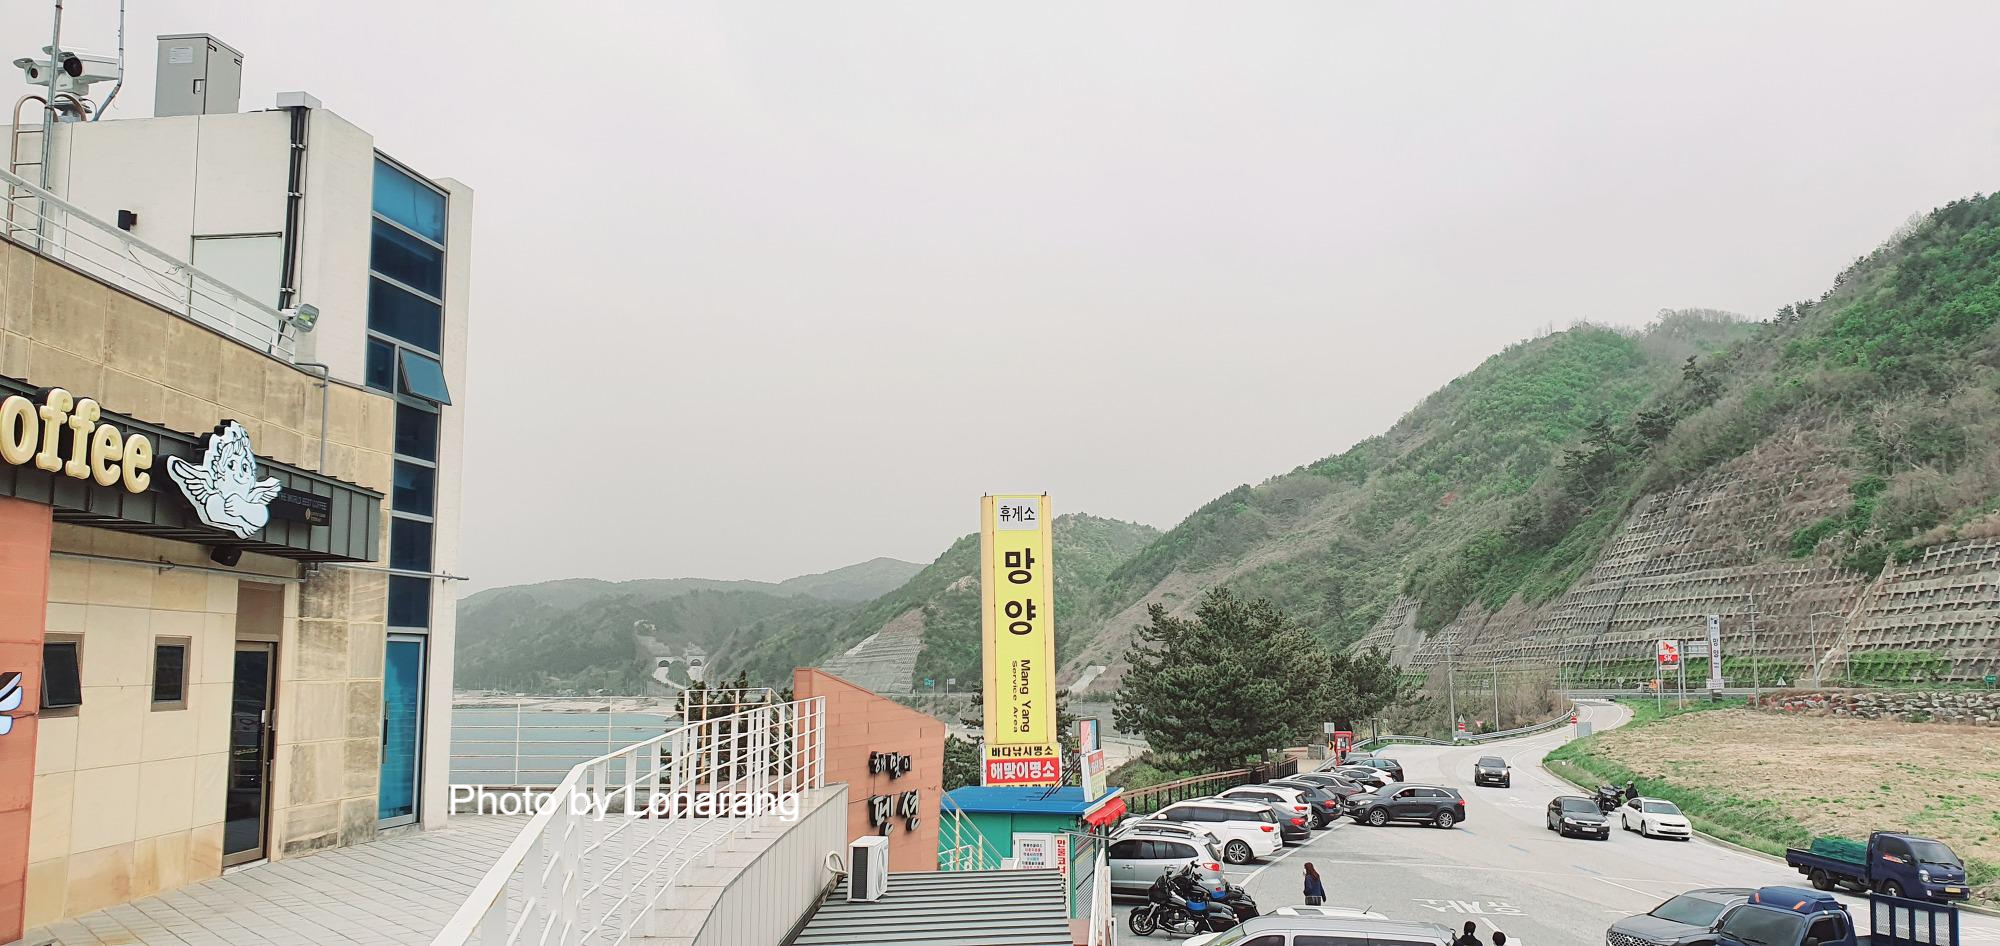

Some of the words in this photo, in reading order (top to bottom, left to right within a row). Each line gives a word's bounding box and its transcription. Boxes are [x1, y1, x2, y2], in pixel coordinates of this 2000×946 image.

[0, 387, 153, 494] offee
[1000, 504, 1036, 523] 휴게소
[1020, 659, 1032, 695] Mang
[1021, 700, 1033, 733] Yang
[873, 751, 912, 779] 해맞이
[992, 746, 1053, 757] 바다낚시명소
[990, 760, 1055, 779] 해맞이명소
[872, 789, 921, 836] 펜션
